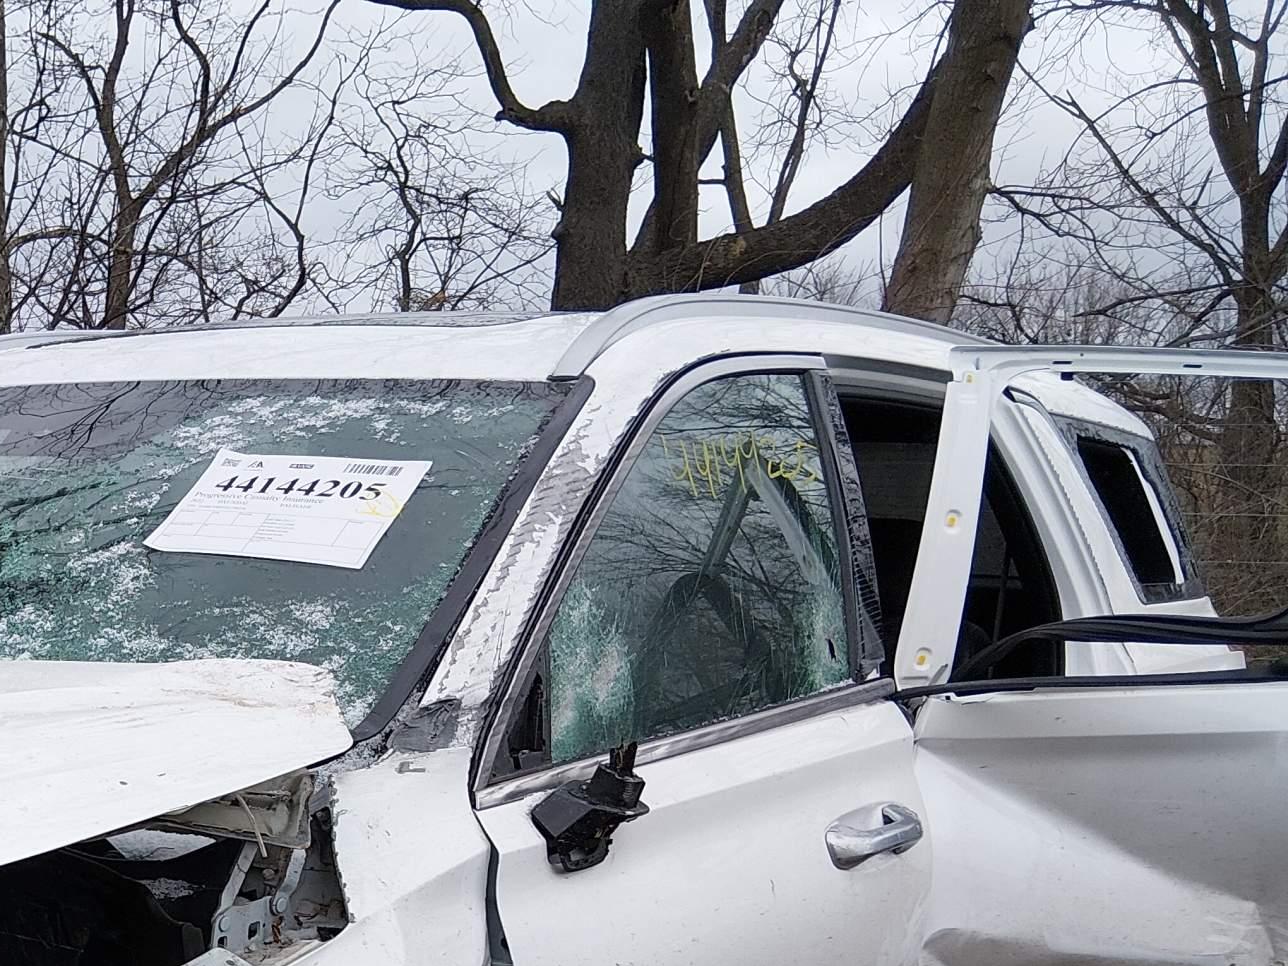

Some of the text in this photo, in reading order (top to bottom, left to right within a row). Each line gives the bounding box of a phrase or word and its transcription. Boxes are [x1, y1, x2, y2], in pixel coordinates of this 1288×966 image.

[194, 490, 243, 500] Progressive
[282, 495, 325, 505] Insurance
[215, 475, 388, 502] 44144205
